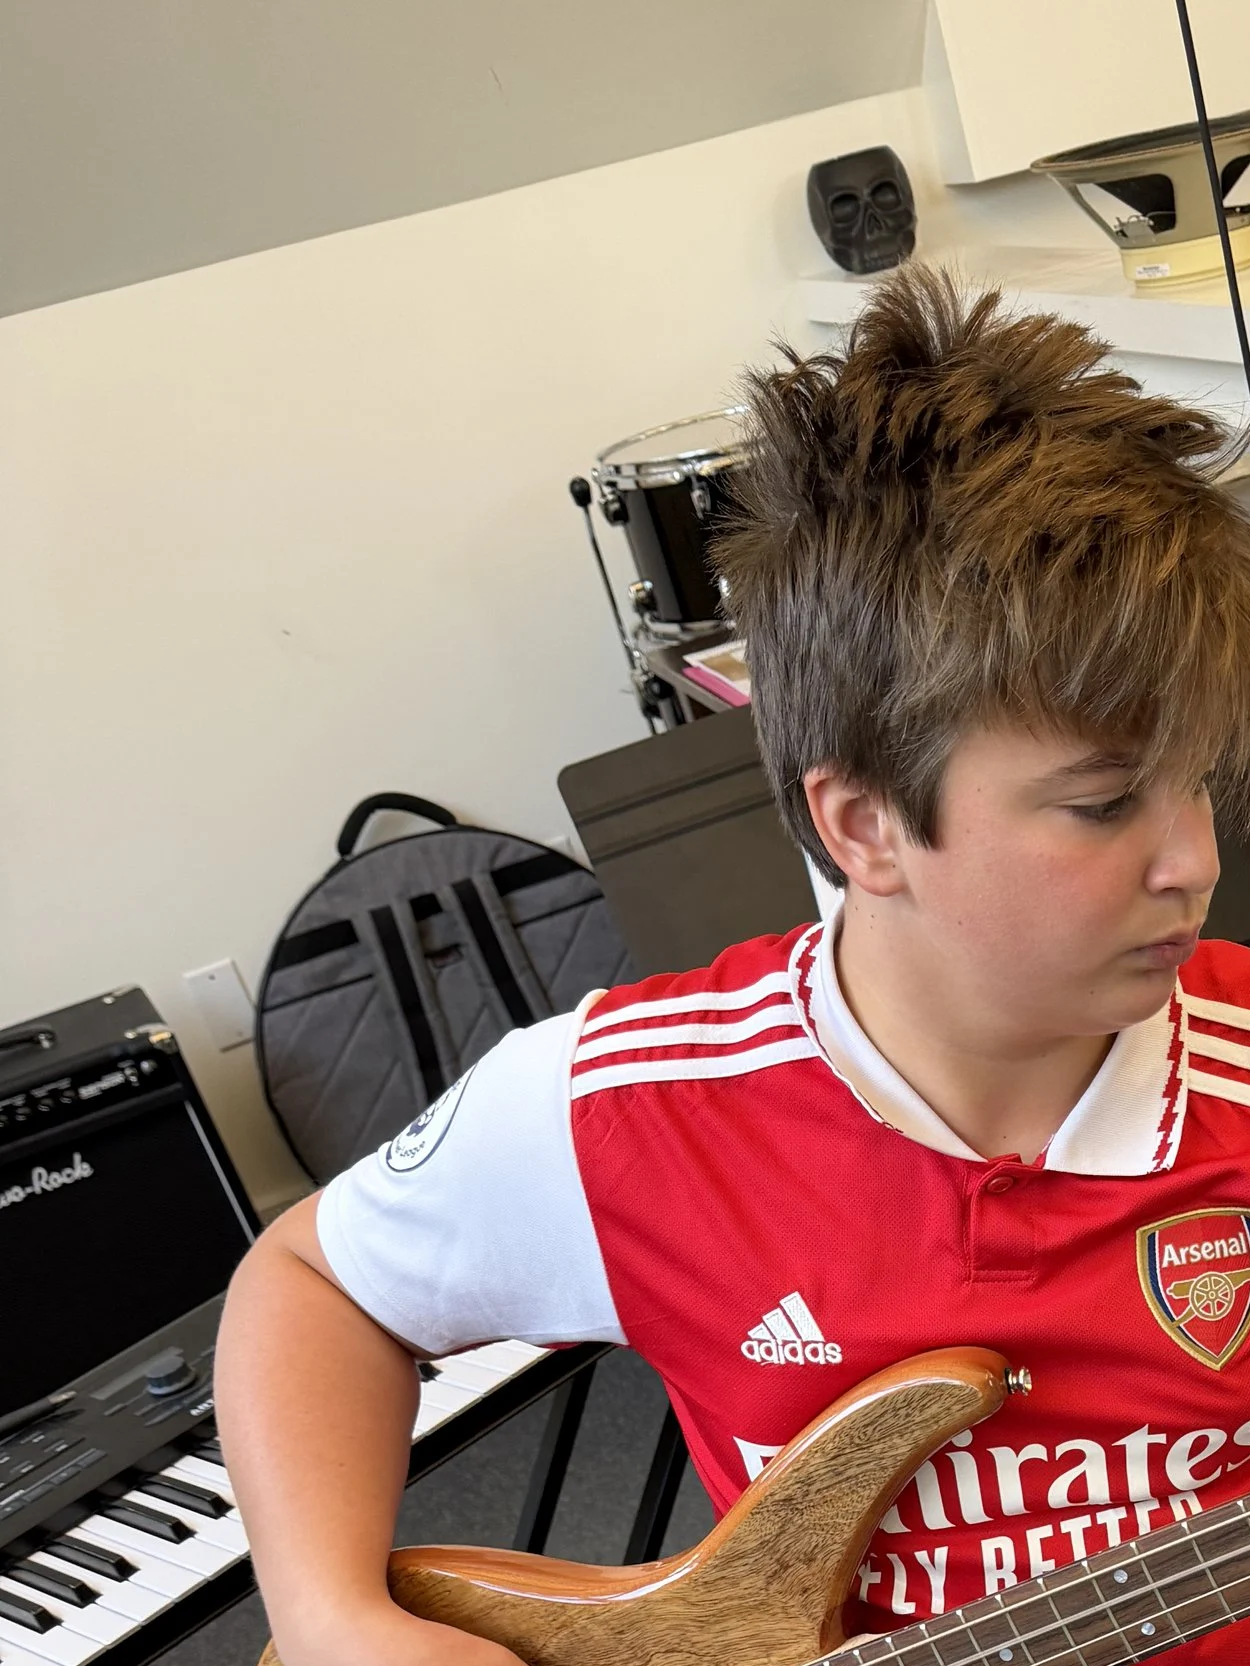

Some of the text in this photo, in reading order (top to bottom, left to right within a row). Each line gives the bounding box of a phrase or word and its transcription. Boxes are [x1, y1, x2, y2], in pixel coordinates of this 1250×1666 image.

[0, 1151, 95, 1209] wo-Rock
[1161, 1232, 1248, 1268] Arsenal
[740, 1338, 843, 1366] adidas
